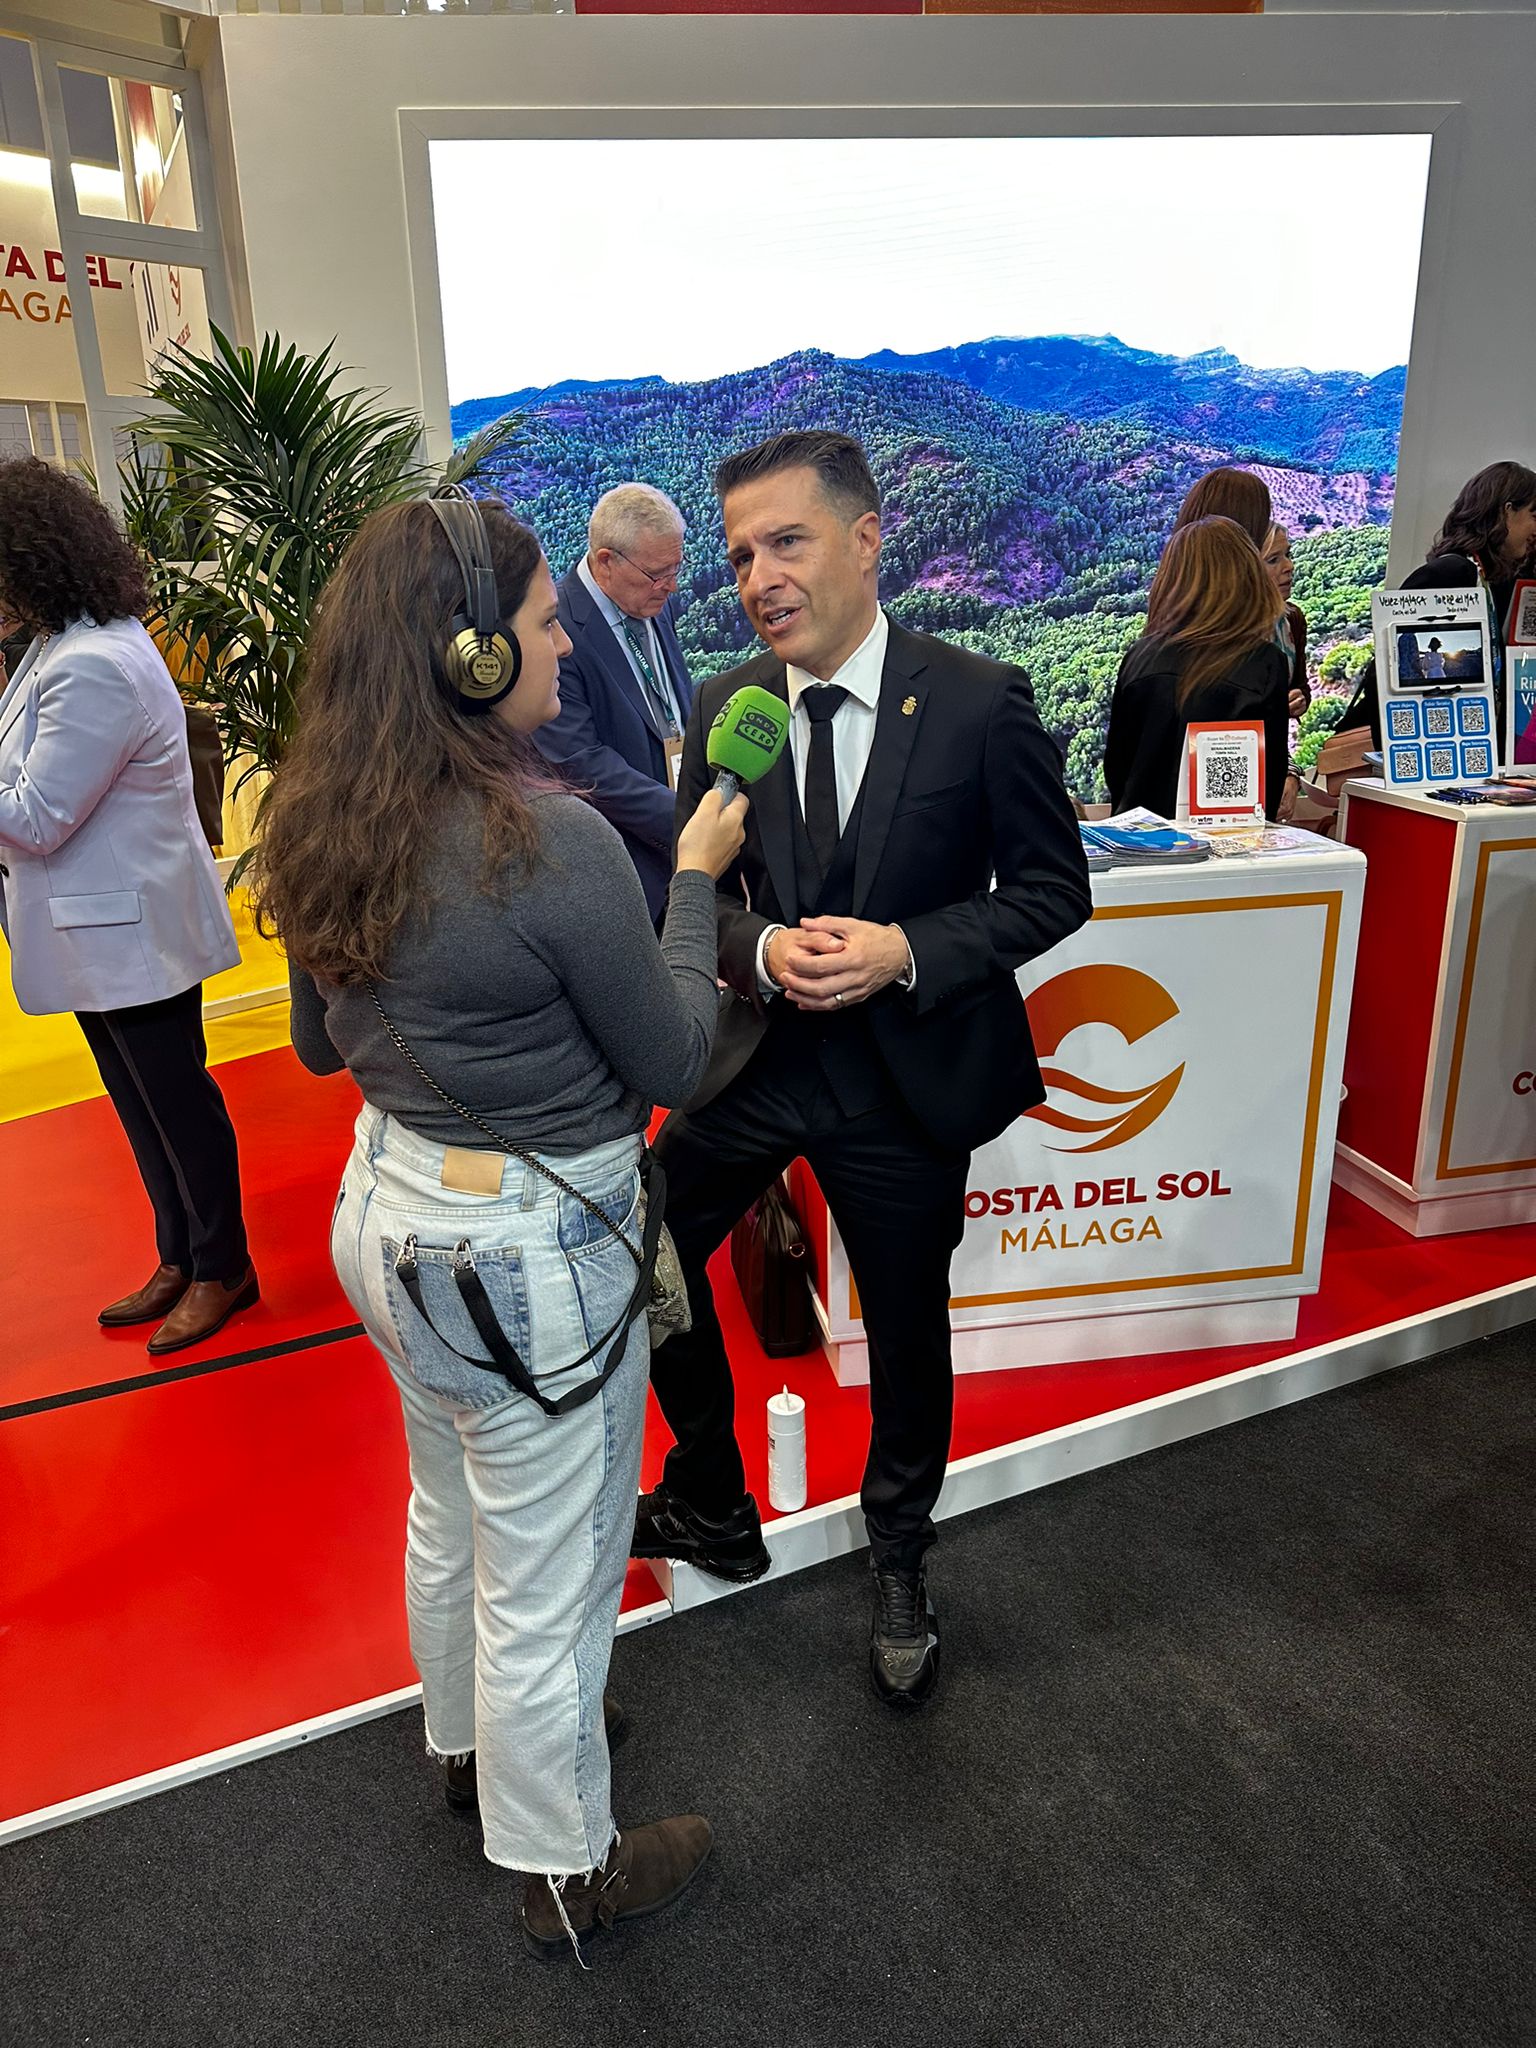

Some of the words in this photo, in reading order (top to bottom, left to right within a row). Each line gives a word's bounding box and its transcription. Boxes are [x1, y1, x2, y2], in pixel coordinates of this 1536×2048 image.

[0, 244, 37, 280] A
[476, 662, 498, 670] K141
[1521, 676, 1536, 690] Ri
[1521, 692, 1536, 706] Vi
[748, 713, 777, 733] ONDA
[743, 725, 773, 746] CERO
[1512, 1070, 1536, 1095] C
[1074, 1177, 1148, 1208] DEL
[1155, 1169, 1231, 1201] SOL
[1001, 1215, 1163, 1254] MÁLAGA
